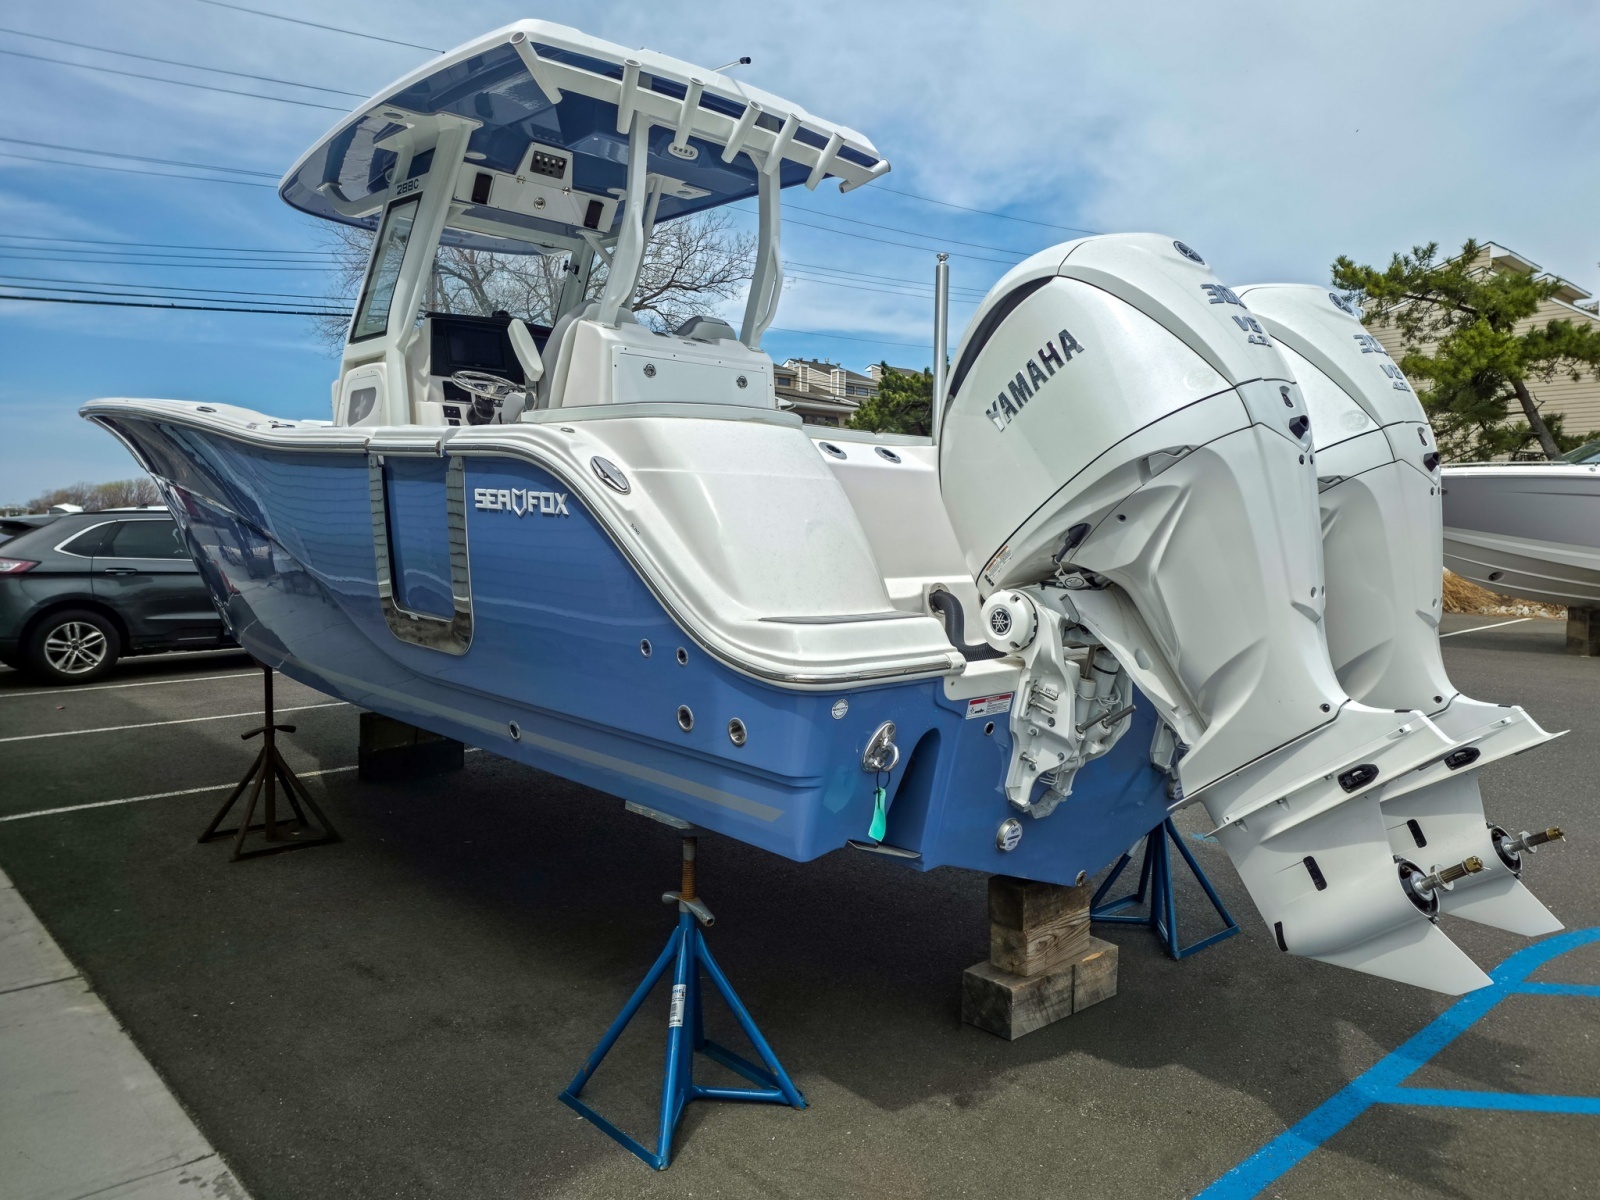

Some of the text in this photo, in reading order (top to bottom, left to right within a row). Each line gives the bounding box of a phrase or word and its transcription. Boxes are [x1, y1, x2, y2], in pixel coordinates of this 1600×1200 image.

[985, 328, 1085, 433] YAMAHA
[474, 488, 570, 516] SEA FOX
